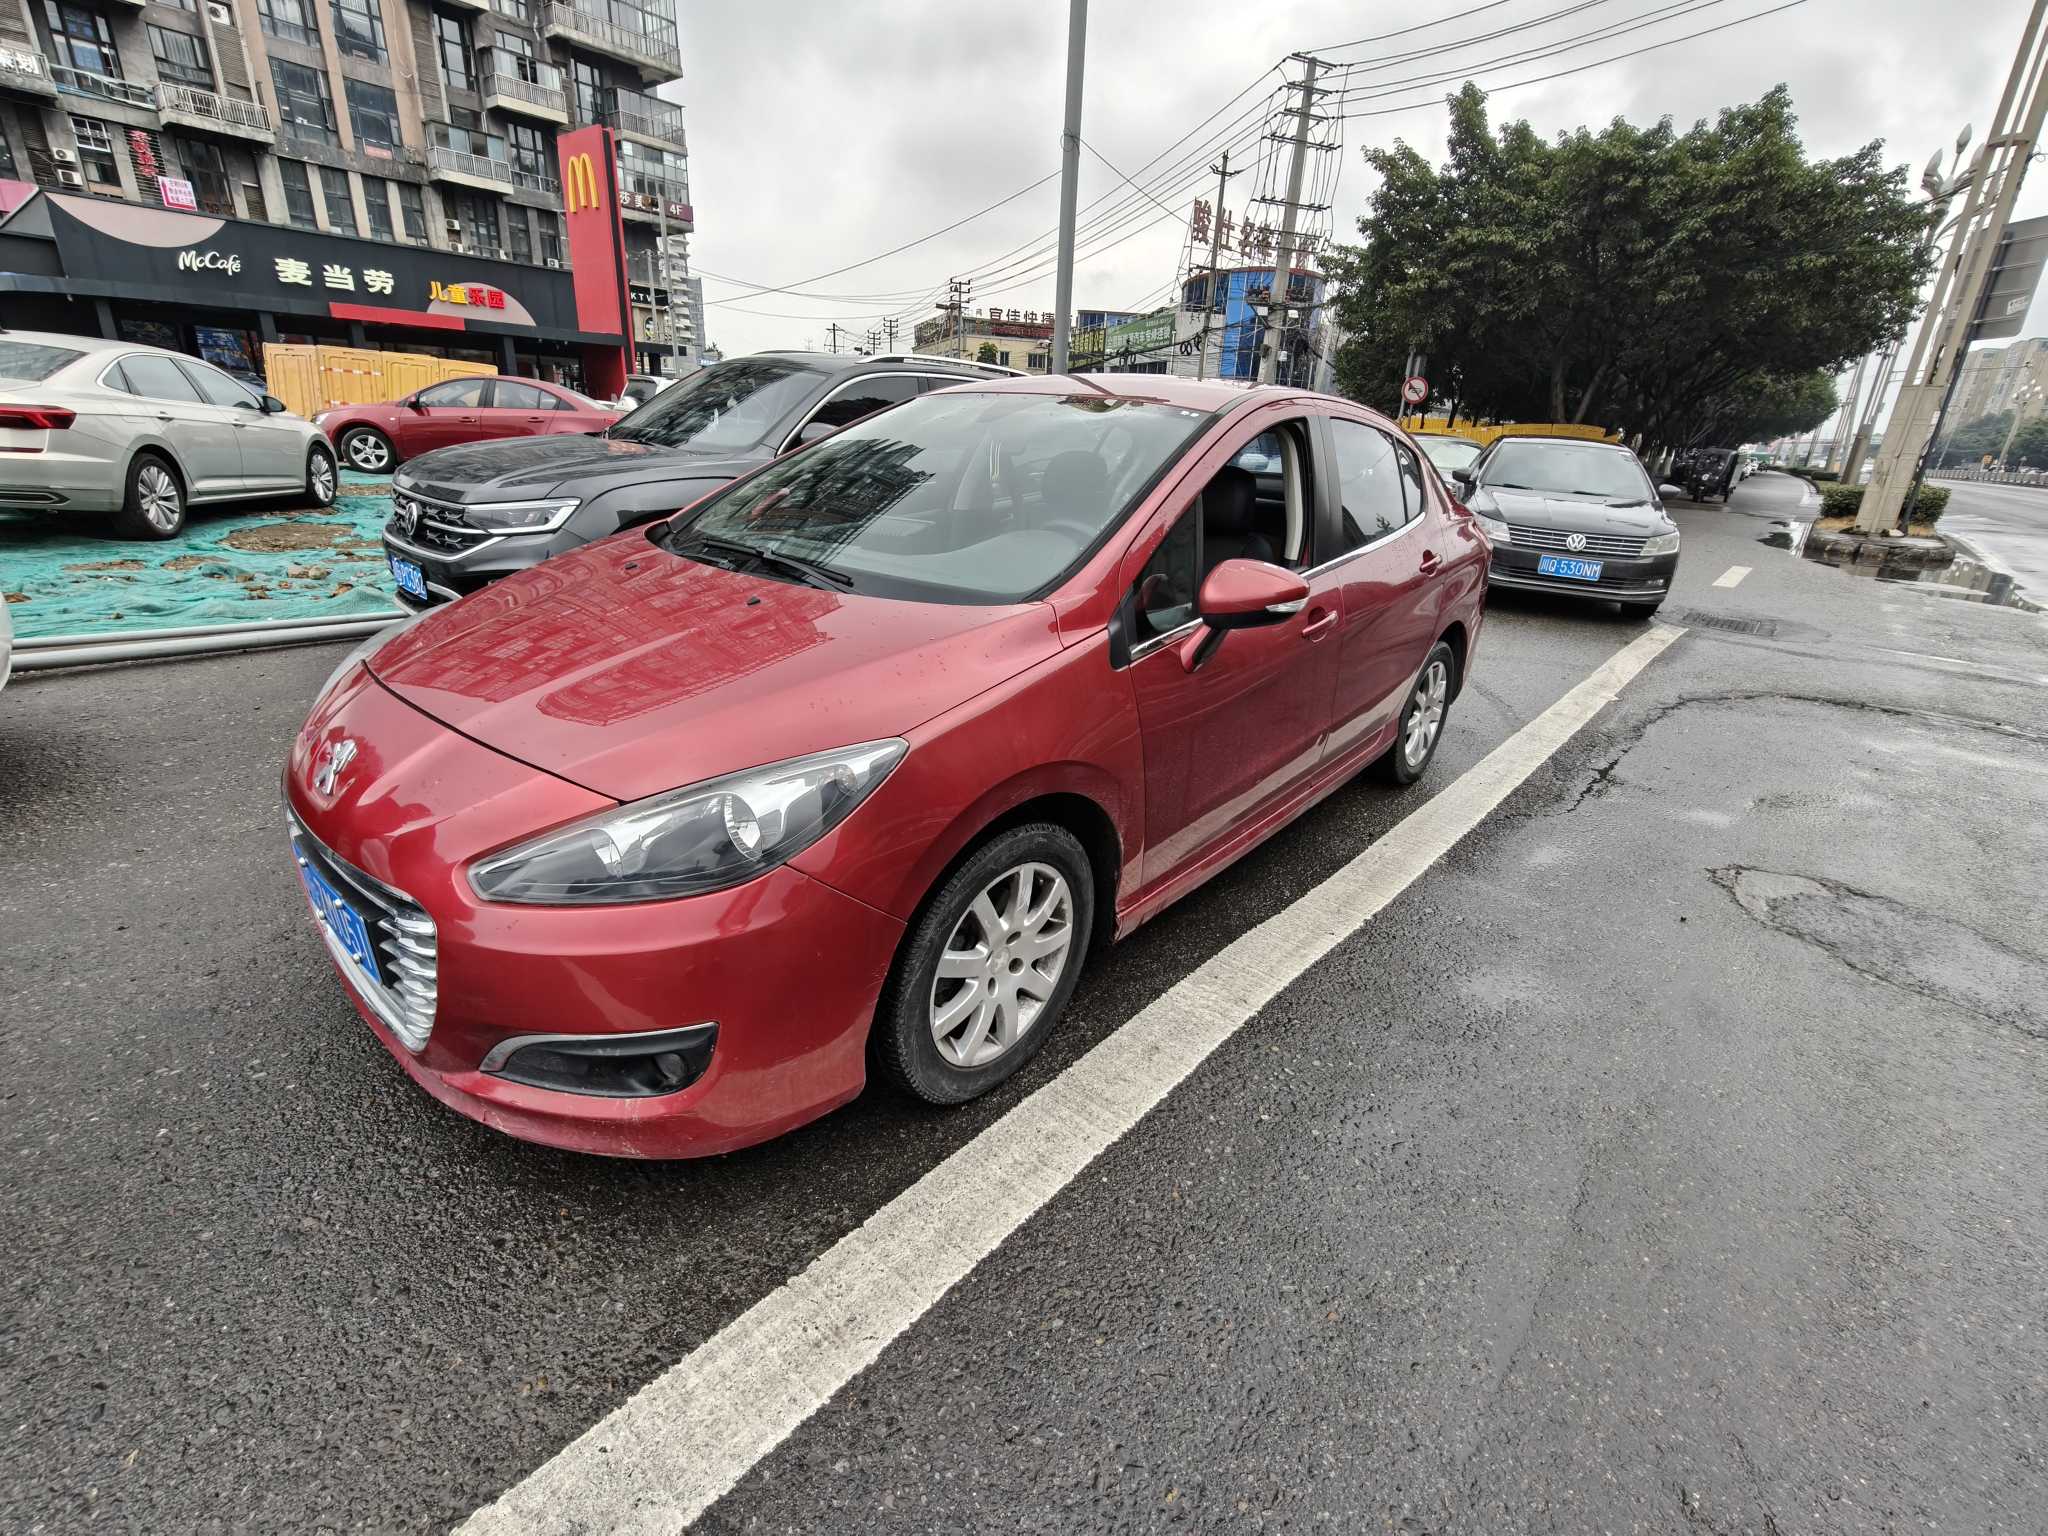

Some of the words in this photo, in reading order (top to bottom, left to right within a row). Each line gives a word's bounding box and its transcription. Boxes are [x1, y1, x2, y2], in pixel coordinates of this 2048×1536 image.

[670, 203, 683, 216] 4F
[274, 257, 395, 295] 麦当劳
[429, 280, 505, 309] 儿童乐园
